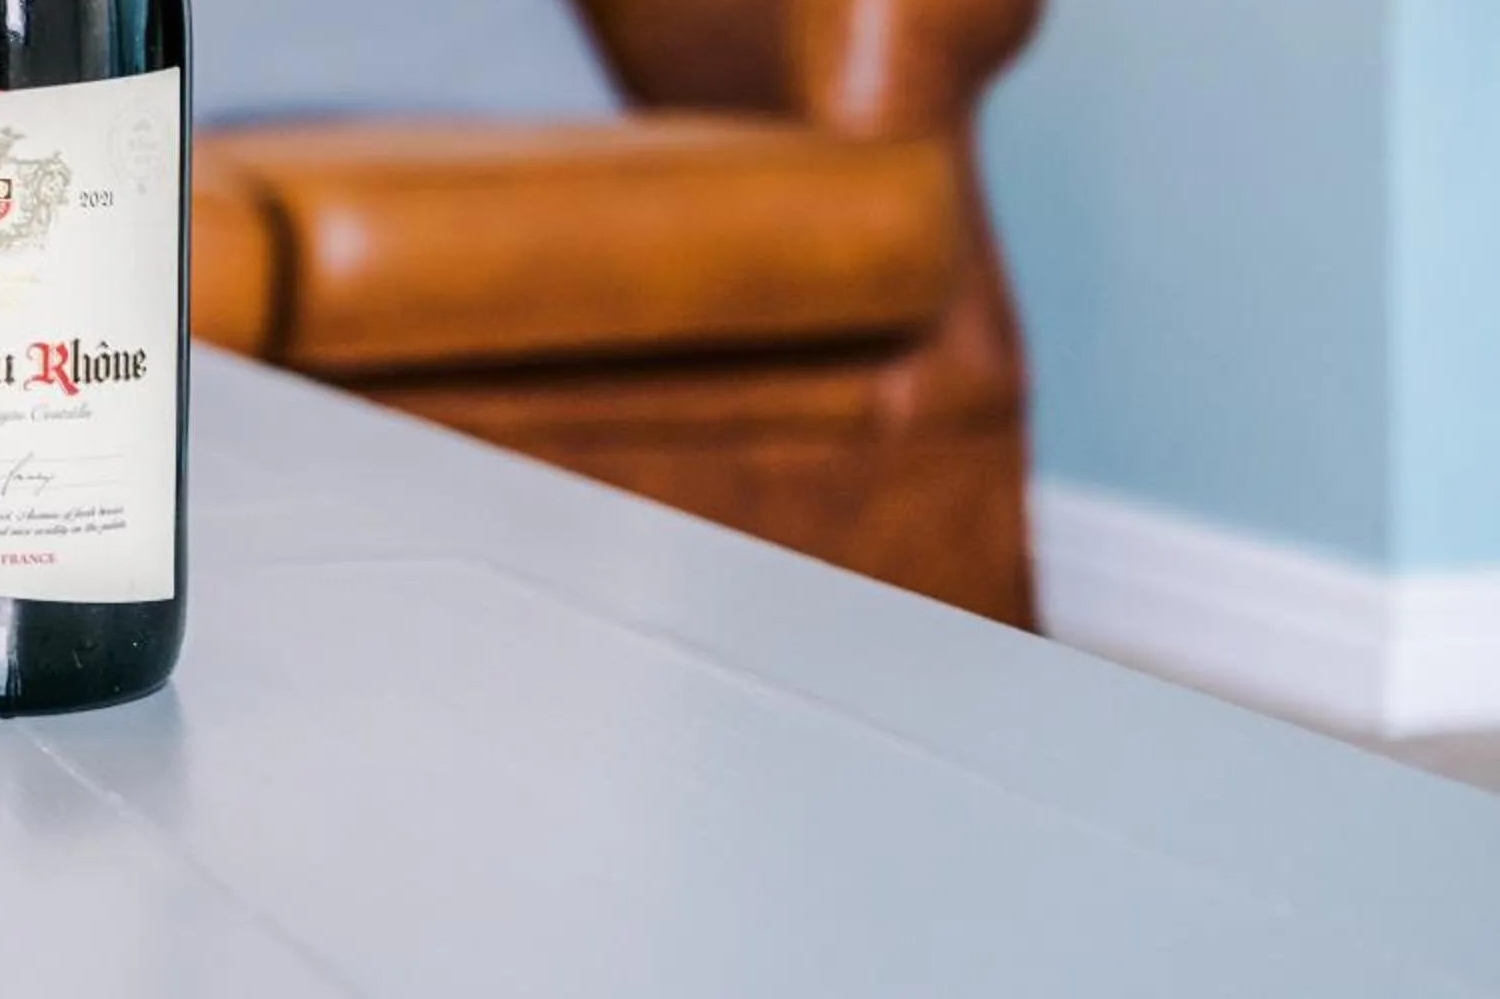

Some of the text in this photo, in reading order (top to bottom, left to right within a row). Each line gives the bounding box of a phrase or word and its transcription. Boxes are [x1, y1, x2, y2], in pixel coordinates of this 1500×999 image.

[79, 190, 114, 207] 2021
[24, 338, 147, 396] Rhône
[1, 552, 56, 565] FRANCE
